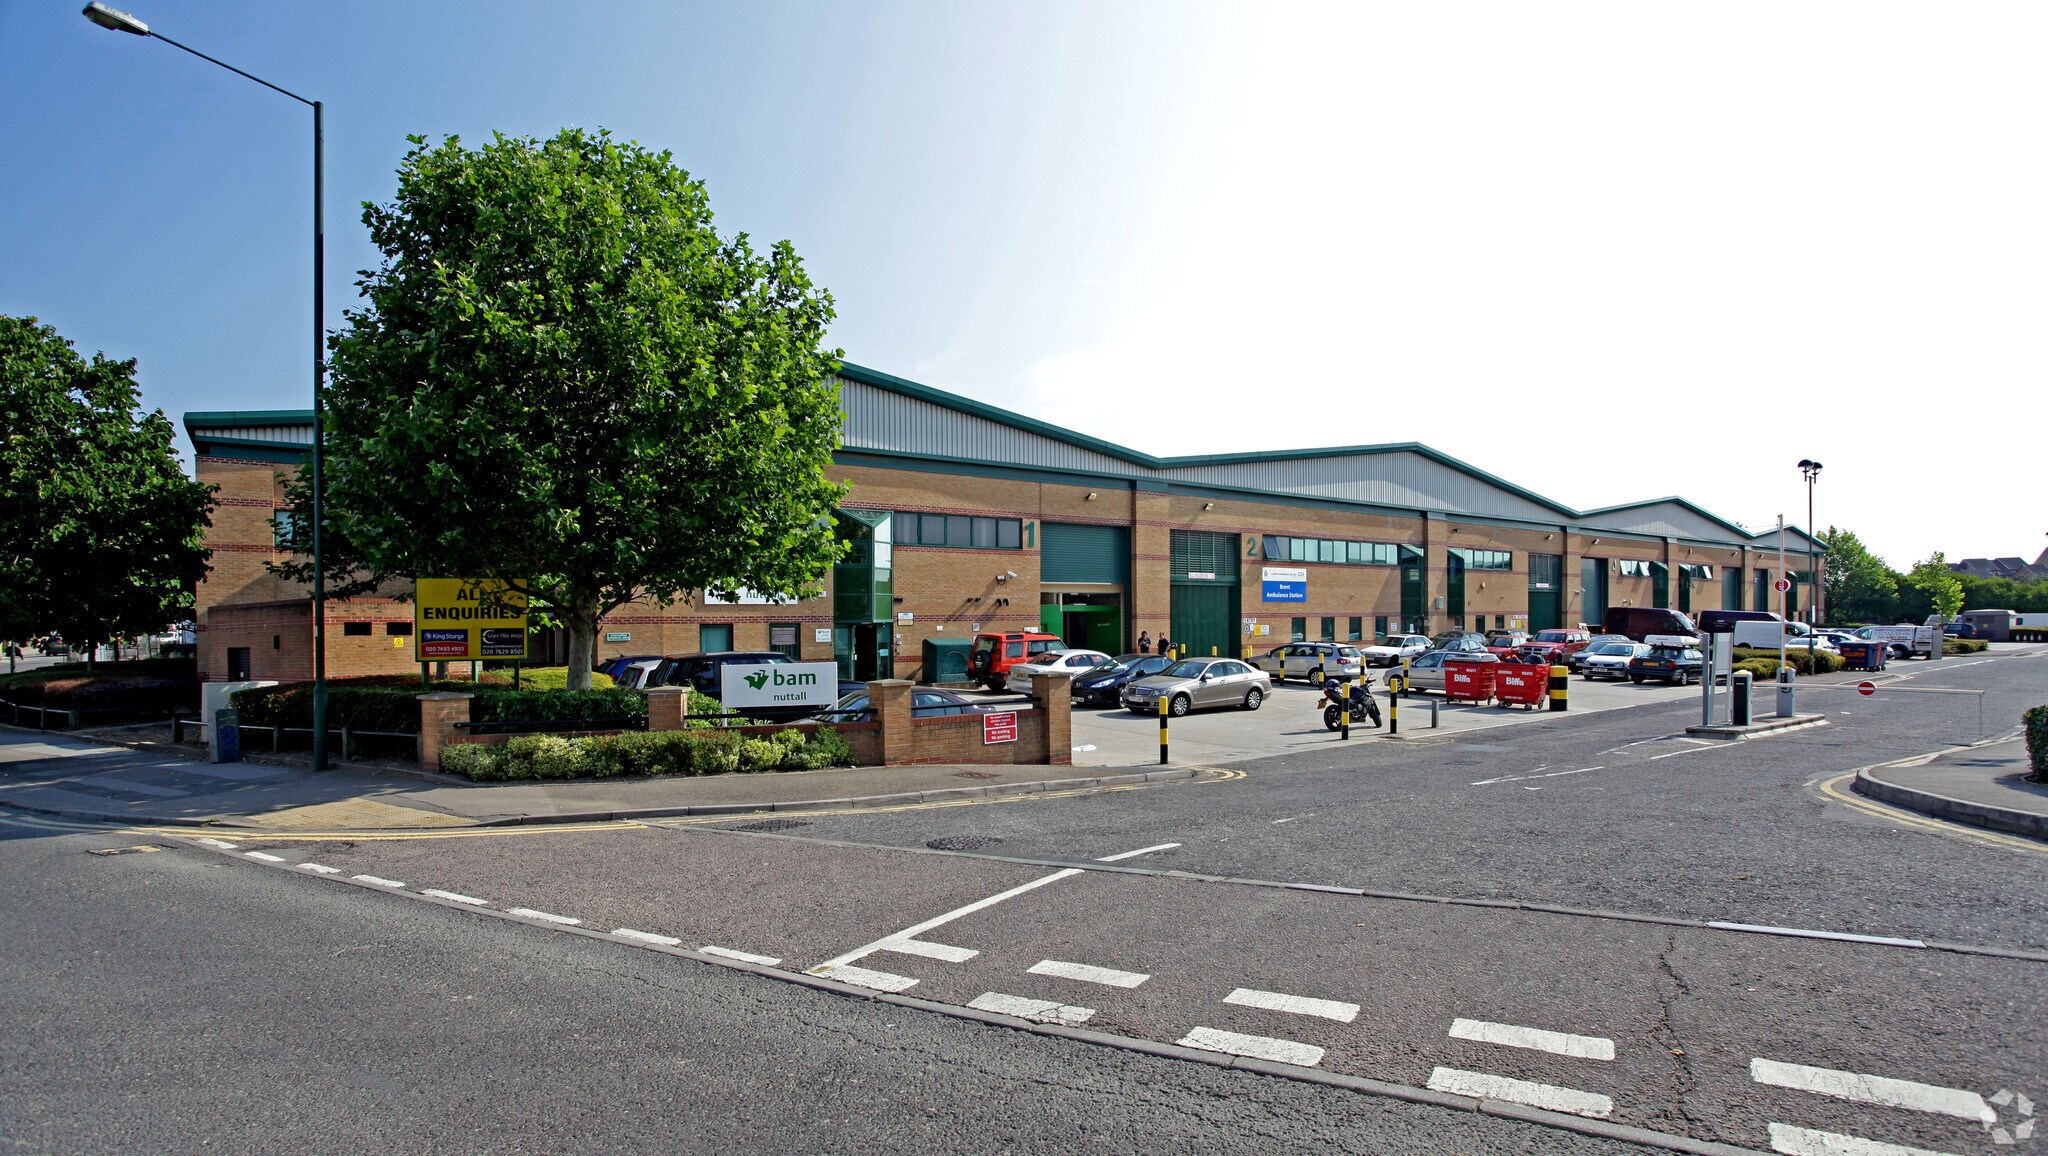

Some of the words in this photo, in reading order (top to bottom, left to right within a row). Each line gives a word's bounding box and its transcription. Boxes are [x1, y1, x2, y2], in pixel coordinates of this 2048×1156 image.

[1025, 521, 1035, 548] 1
[1247, 536, 1258, 557] 2
[423, 607, 521, 620] ENQUIRIES
[773, 668, 817, 686] bam
[1454, 674, 1471, 683] Biffa
[1506, 677, 1525, 686] Biffa
[773, 692, 807, 701] nuttall
